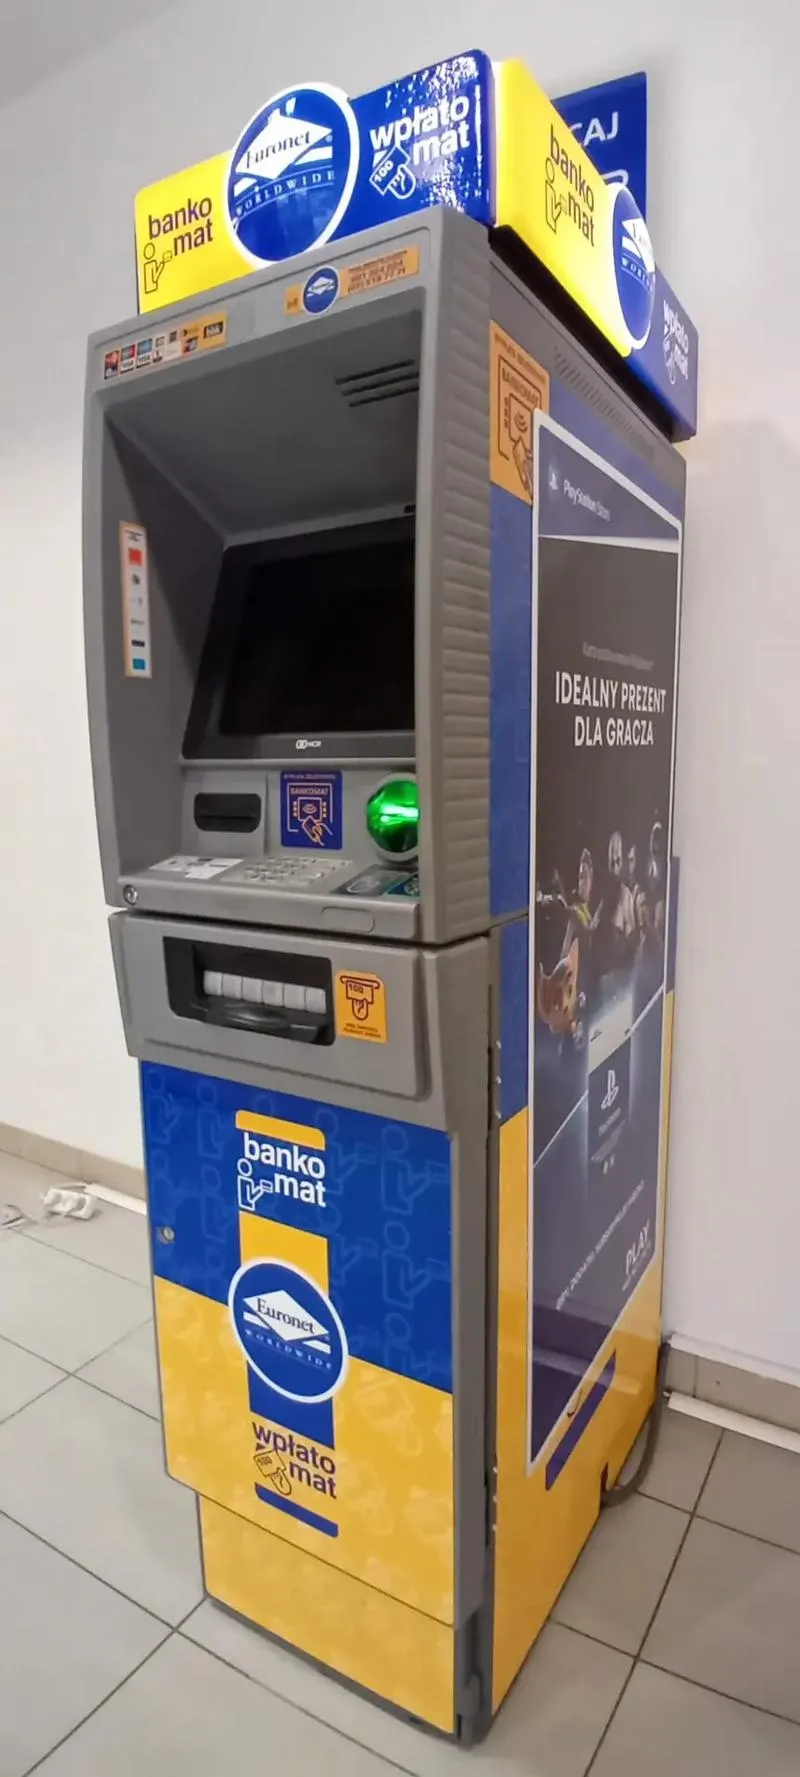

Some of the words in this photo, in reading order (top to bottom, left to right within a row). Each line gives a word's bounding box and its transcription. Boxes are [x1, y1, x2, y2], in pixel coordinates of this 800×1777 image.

[246, 130, 310, 169] Euronet
[413, 120, 470, 167] mat
[374, 160, 394, 183] 100
[551, 123, 594, 213] banko
[236, 171, 335, 216] WORLDWIDE
[149, 197, 212, 241] banko
[173, 218, 213, 256] mat
[568, 191, 594, 248] mat
[556, 670, 618, 709] IDEALNY
[621, 682, 666, 713] PREZENT
[574, 715, 603, 747] DLA
[606, 717, 654, 747] GRACZA
[348, 983, 364, 994] 100
[244, 1132, 326, 1179] banko
[274, 1173, 326, 1207] mat
[625, 1217, 650, 1276] PLAY
[256, 1297, 316, 1334] Euronet
[244, 1328, 332, 1370] WORLDWIDE
[252, 1421, 336, 1475] wpłato
[289, 1461, 337, 1500] mat
